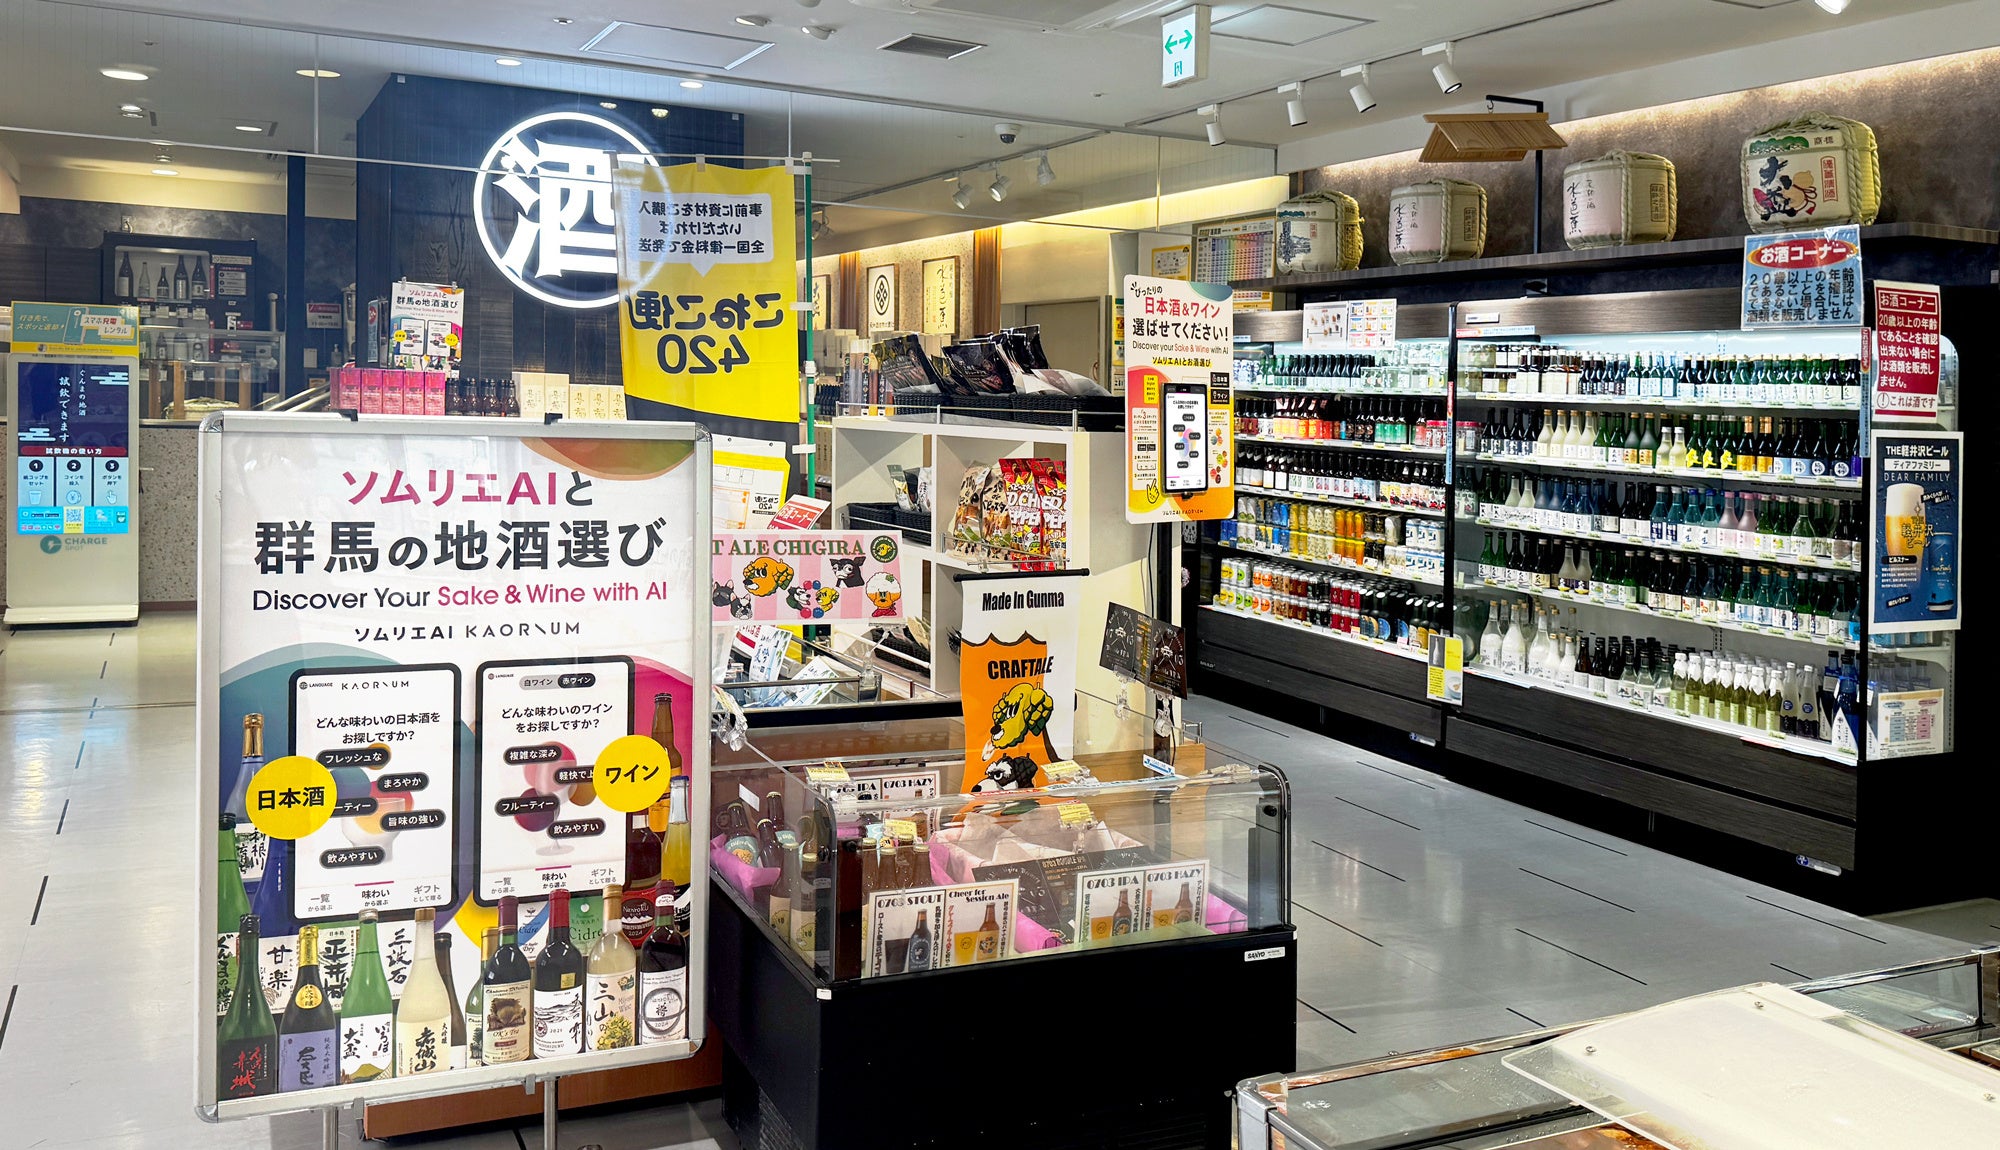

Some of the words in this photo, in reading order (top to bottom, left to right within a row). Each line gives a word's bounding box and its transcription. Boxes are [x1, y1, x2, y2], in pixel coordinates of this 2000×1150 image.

[492, 134, 645, 279] 酒
[1760, 244, 1847, 264] お酒コーナー
[1135, 285, 1163, 298] ぴったりの
[1748, 281, 1855, 298] であることを確認
[397, 296, 458, 309] 群馬の地酒選び
[1748, 295, 1855, 310] できない場合には
[1880, 293, 1936, 309] お酒コーナー
[84, 317, 117, 325] スマホ充電
[1747, 308, 1854, 322] 酒類を販売しません
[1879, 314, 1938, 331] 20歳以上の年齢
[104, 326, 128, 334] レンタル
[1879, 330, 1939, 346] であることを確認
[1132, 340, 1159, 351] Discover
[1159, 344, 1174, 352] your
[1174, 343, 1189, 352] Sake
[1195, 345, 1210, 353] Wine
[1880, 345, 1936, 360] 出来ない場合に
[1880, 361, 1935, 375] は酒類を販売し
[1880, 375, 1907, 389] ません。
[78, 369, 87, 416] ぐんまの地酒
[1890, 396, 1936, 409] これは酒です
[59, 376, 70, 443] 試飲できます
[1885, 445, 1949, 457] THE軽井沢ビール
[1893, 461, 1941, 469] ディアファミリー
[1884, 472, 1909, 482] DEAR
[1915, 472, 1950, 482] FAMILY
[342, 469, 594, 508] ソムリエAIと
[64, 537, 108, 545] CHARGE
[254, 516, 667, 575] 群馬の地酒選び
[728, 540, 770, 556] ALE
[773, 540, 866, 556] CHIGIRA
[253, 588, 368, 611] Discover
[376, 587, 430, 609] Your
[438, 585, 499, 607] Sake
[504, 585, 521, 605] &
[526, 583, 585, 604] Wine
[592, 581, 640, 602] with
[645, 581, 667, 600] AI
[982, 592, 1012, 611] Made
[1013, 590, 1024, 609] In
[1027, 590, 1064, 608] Gunma
[355, 626, 453, 642] ソムリエAI
[987, 656, 1054, 680] CRAFTALE
[524, 678, 553, 687] 白ワイン
[562, 676, 591, 686] 赤ワイン
[501, 703, 613, 719] どんな味わいのワイン
[316, 712, 441, 729] どんな味わいの日本酒を
[515, 718, 600, 733] をお探しですか?
[342, 730, 416, 744] お探しですか?
[325, 752, 383, 763] フレッシュな
[509, 749, 558, 761] 複雑な深み
[605, 764, 660, 785] ワイン
[383, 777, 422, 788] まろやか
[857, 783, 877, 792] IPA
[884, 780, 906, 789] 0703
[908, 778, 933, 787] HAZY
[257, 786, 326, 811] 日本酒
[501, 800, 555, 812] フルーティー
[388, 814, 439, 826] 旨味の強い
[554, 823, 599, 835] 飲みやすい
[327, 851, 378, 863] 飲みやすい
[542, 872, 567, 882] 味わい
[591, 868, 614, 877] ギフト
[1147, 871, 1172, 882] 0703
[1175, 869, 1201, 880] HAZY
[494, 877, 512, 886] 一覧
[542, 881, 567, 889] から選ぶ
[1087, 878, 1115, 889] 0703
[1118, 875, 1139, 886] IPA
[362, 888, 390, 900] 味わい
[414, 884, 440, 895] ギフト
[491, 886, 516, 895] から選ぶ
[311, 894, 331, 904] 一覧
[364, 899, 389, 907] から選ぶ
[413, 894, 442, 903] として贈る
[907, 894, 942, 905] STOUT
[966, 894, 994, 903] Session
[308, 904, 333, 912] から選ぶ
[1248, 951, 1265, 959] SANYO
[266, 944, 293, 991] 甘楽
